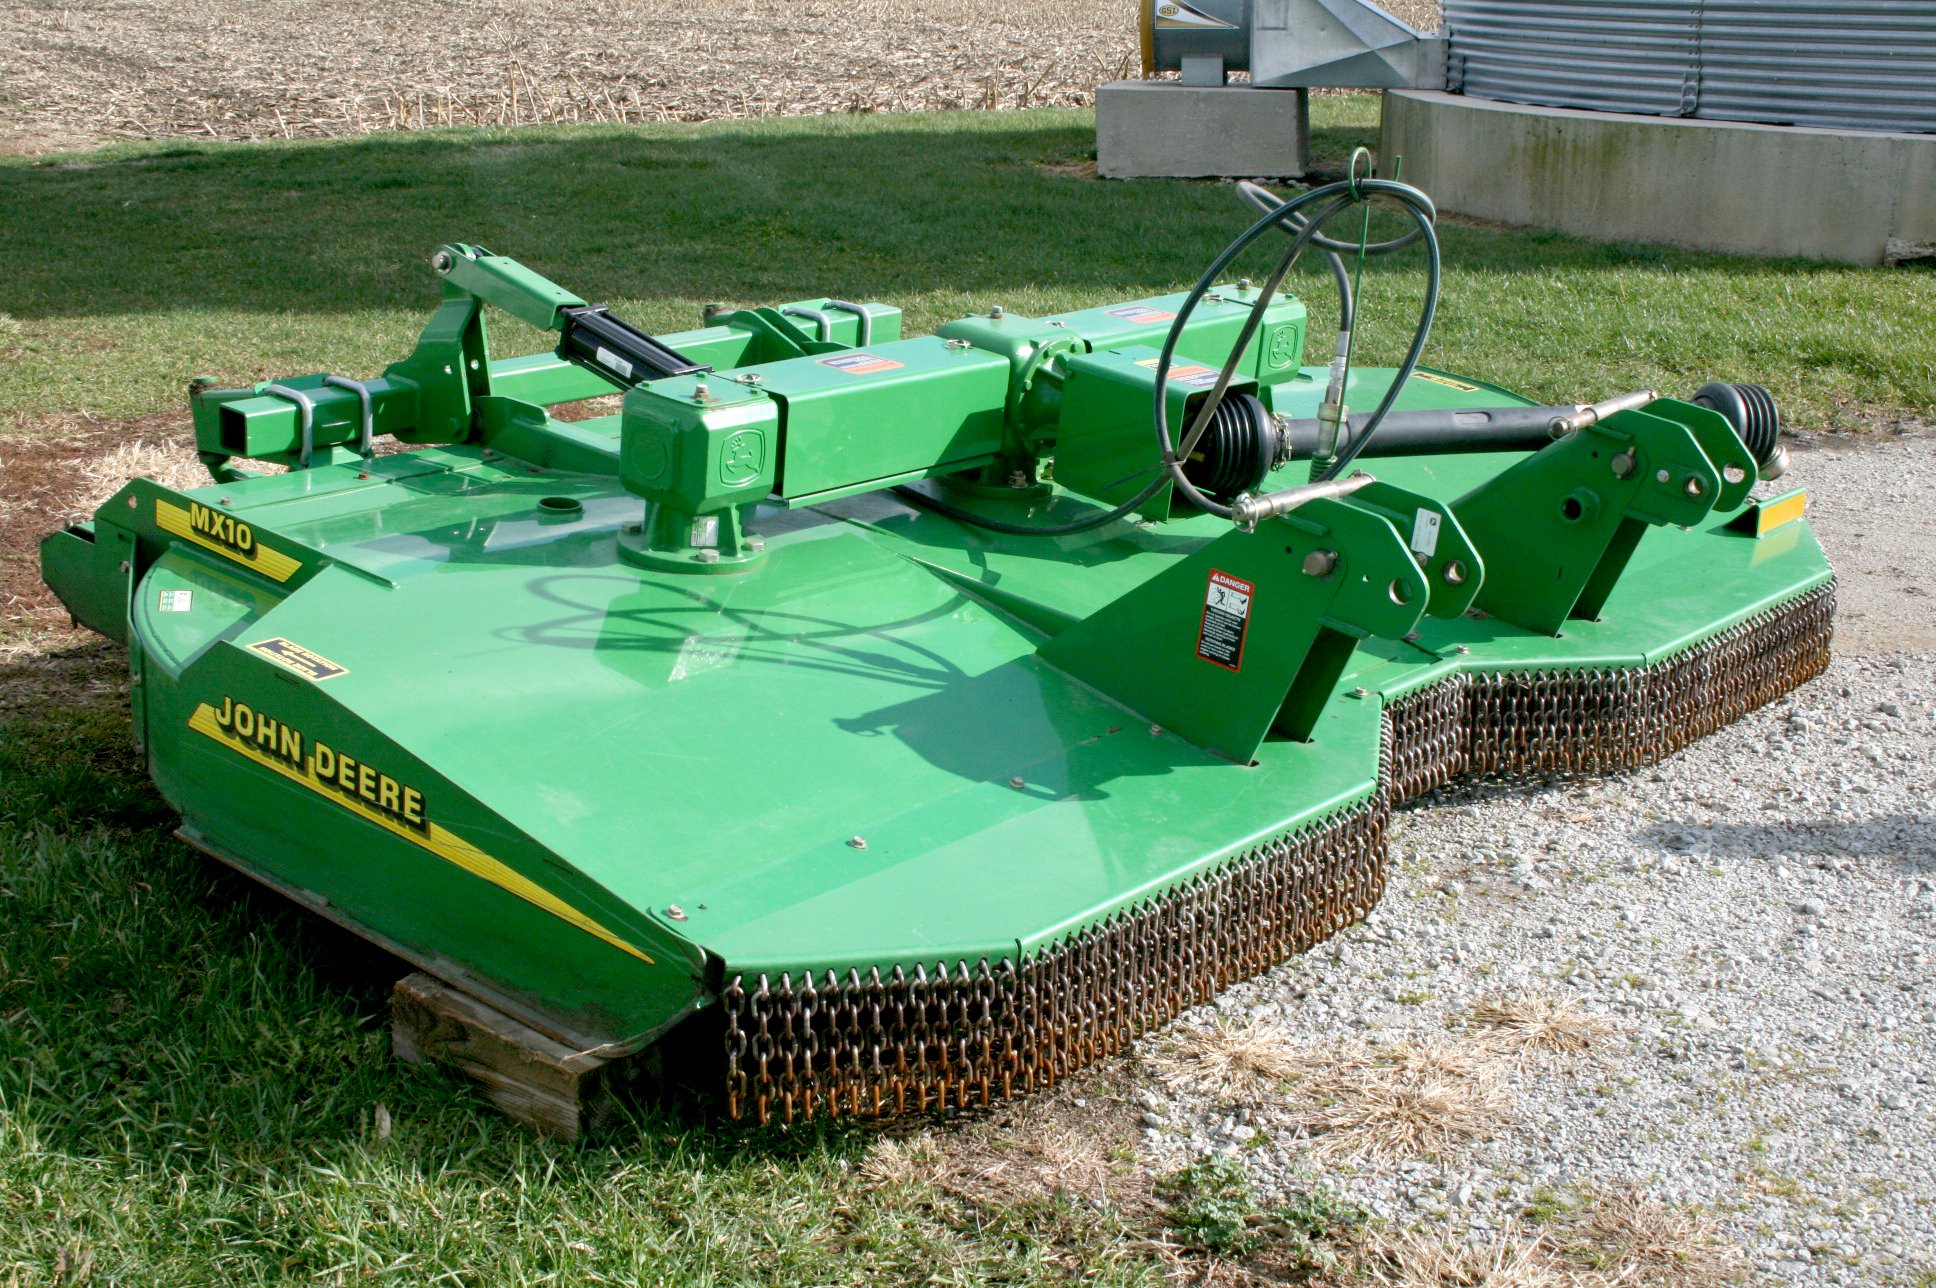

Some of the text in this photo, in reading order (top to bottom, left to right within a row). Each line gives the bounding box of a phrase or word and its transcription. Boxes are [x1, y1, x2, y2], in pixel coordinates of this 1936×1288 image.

[1161, 6, 1177, 15] GSI
[190, 501, 253, 551] MX10
[1219, 575, 1250, 593] DANGER
[214, 696, 423, 826] JOHN DEERE
